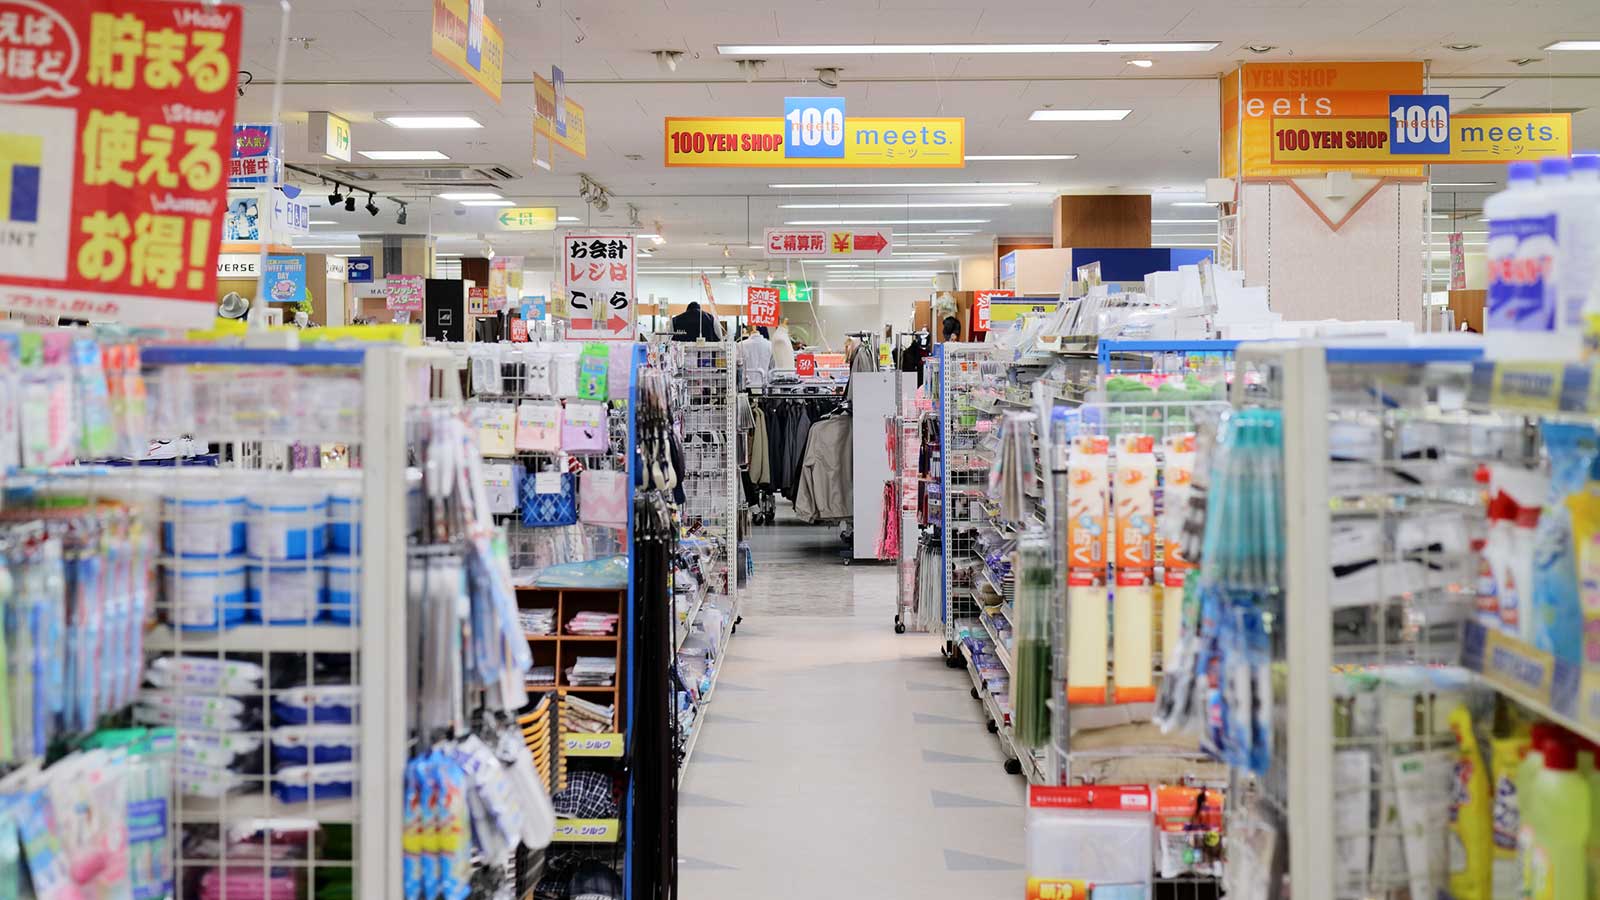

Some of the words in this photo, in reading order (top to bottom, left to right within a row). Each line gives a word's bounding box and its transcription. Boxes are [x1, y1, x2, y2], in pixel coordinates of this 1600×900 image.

[87, 12, 231, 93] 貯まる
[0, 48, 65, 81] ほど
[1288, 69, 1338, 88] SHOP
[671, 132, 705, 154] 100
[706, 133, 738, 152] YEN
[741, 133, 783, 152] SHOP
[786, 107, 843, 146] 100
[856, 126, 953, 145] meets.
[1276, 129, 1310, 151] 100
[1311, 131, 1343, 149] YEN
[1345, 131, 1388, 149] SHOP
[1391, 105, 1448, 143] 100
[1461, 123, 1559, 142] meets.
[82, 109, 224, 191] 使える
[886, 148, 918, 159] ミーツ
[1491, 144, 1524, 155] ミーツ
[231, 158, 269, 176] 開催中
[77, 210, 211, 290] お得!
[570, 239, 628, 259] お会計
[770, 234, 824, 251] ご精算所
[570, 261, 628, 282] レジは
[570, 290, 629, 310] こら
